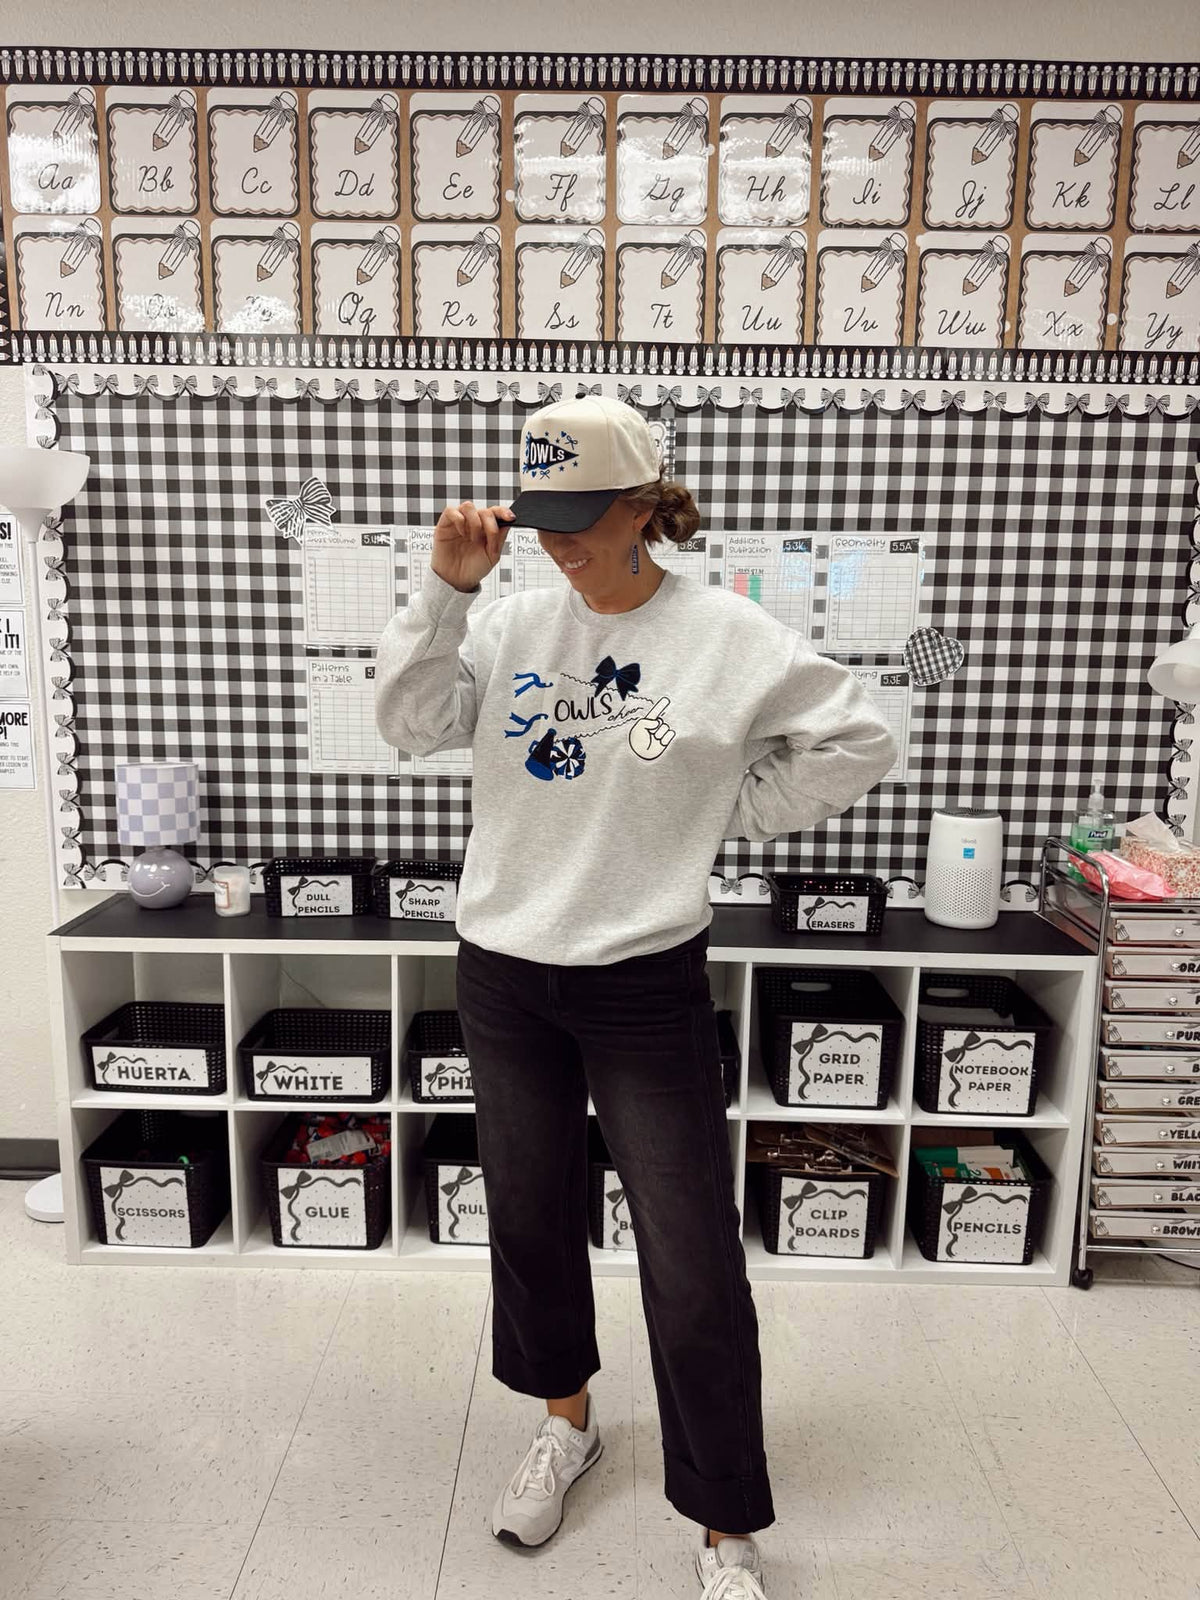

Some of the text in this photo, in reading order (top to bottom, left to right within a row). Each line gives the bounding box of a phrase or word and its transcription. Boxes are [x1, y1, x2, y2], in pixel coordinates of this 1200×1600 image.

[38, 163, 76, 191] Aa
[138, 165, 174, 193] Bb
[241, 167, 272, 194] Cc
[334, 169, 374, 197] Dd
[442, 172, 474, 199] Ee
[746, 176, 786, 202] Hh
[545, 173, 578, 212] Ff
[643, 174, 685, 213] Gg
[852, 177, 881, 206] Ii
[955, 180, 987, 218] Jj
[1052, 181, 1091, 208] Kk
[1153, 182, 1191, 211] Ll
[45, 291, 85, 318] Nn
[338, 291, 376, 335] Qq
[441, 301, 478, 327] Rr
[544, 302, 580, 329] Ss
[650, 303, 674, 329] Tt
[741, 305, 782, 331] Uu
[844, 307, 878, 333] Vv
[937, 309, 987, 336] Ww
[1042, 311, 1083, 338] Xx
[1144, 312, 1183, 350] Yy
[529, 441, 565, 465] OWLS
[311, 663, 350, 672] Patterns
[331, 675, 352, 683] Table
[554, 692, 613, 722] OWLS
[298, 906, 341, 914] PENCILS
[306, 894, 331, 902] DULL
[408, 898, 441, 906] SHARP
[404, 910, 446, 920] PENCILS
[811, 920, 856, 930] ERASERS
[818, 1053, 861, 1065] GRID
[953, 1065, 1030, 1077] NOTEBOOK
[117, 1064, 192, 1082] HUERTA
[273, 1074, 344, 1091] WHITE
[812, 1072, 864, 1086] PAPER
[968, 1081, 1012, 1093] PAPER
[117, 1207, 186, 1219] SCISSORS
[304, 1206, 350, 1219] GLUE
[458, 1204, 487, 1216] RUL
[810, 1209, 848, 1221] CLIP
[794, 1226, 861, 1239] BOARDS
[953, 1222, 1022, 1235] PENCILS
